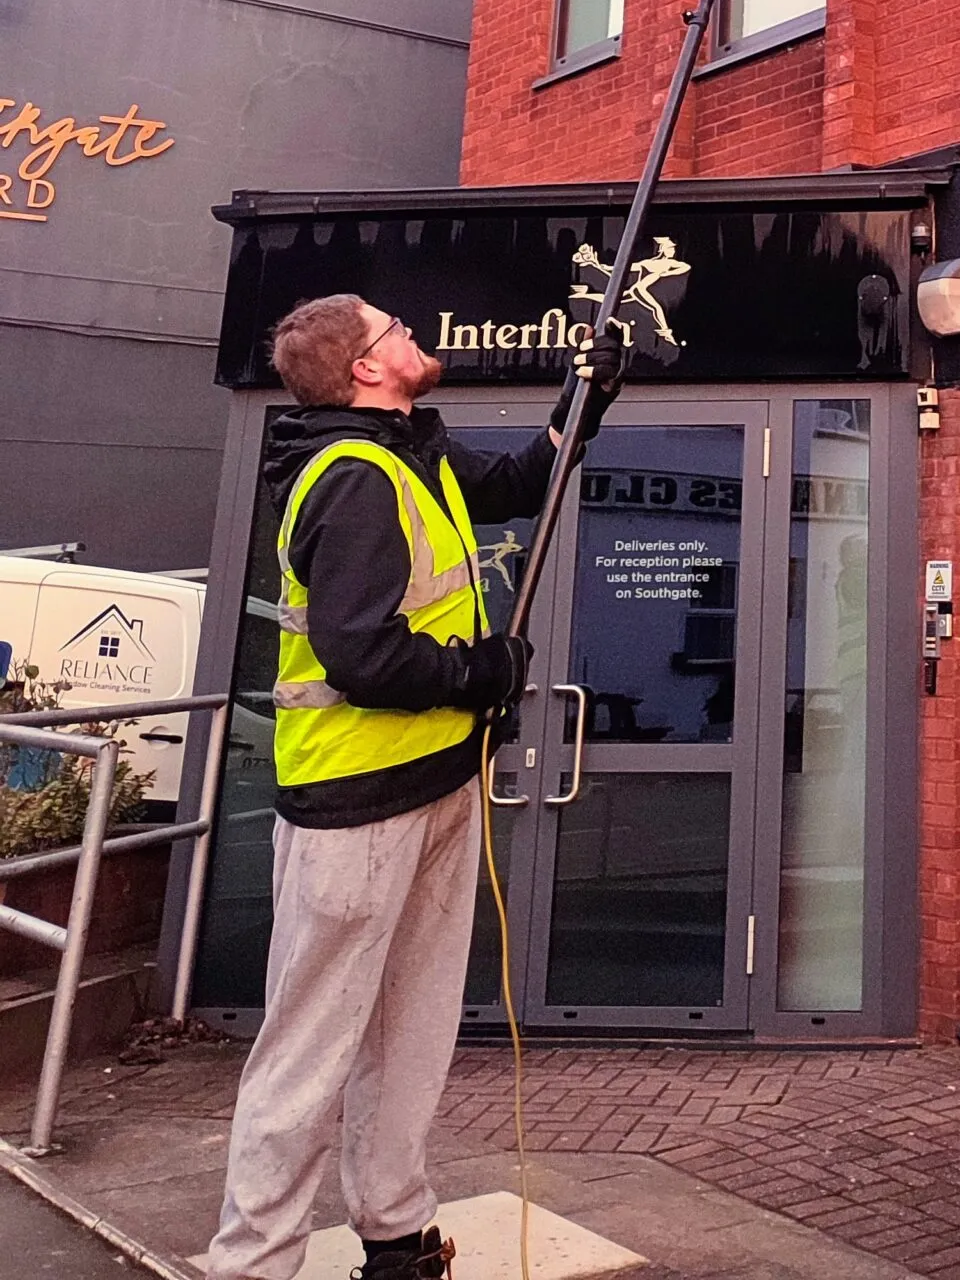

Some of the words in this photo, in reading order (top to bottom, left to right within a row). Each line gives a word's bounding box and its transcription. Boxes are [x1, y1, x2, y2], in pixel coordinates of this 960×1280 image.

[435, 308, 635, 350] Interflo
[614, 540, 676, 552] Deliveries
[678, 540, 709, 553] only.
[595, 556, 617, 567] For
[620, 555, 679, 569] reception
[682, 555, 723, 569] please
[606, 573, 628, 583] use
[631, 572, 652, 583] the
[654, 572, 710, 583] entrance
[615, 589, 632, 599] on
[634, 587, 703, 600] Southgate.
[60, 658, 153, 684] RELIANCE
[89, 681, 120, 692] Cleaning
[121, 684, 152, 694] Services
